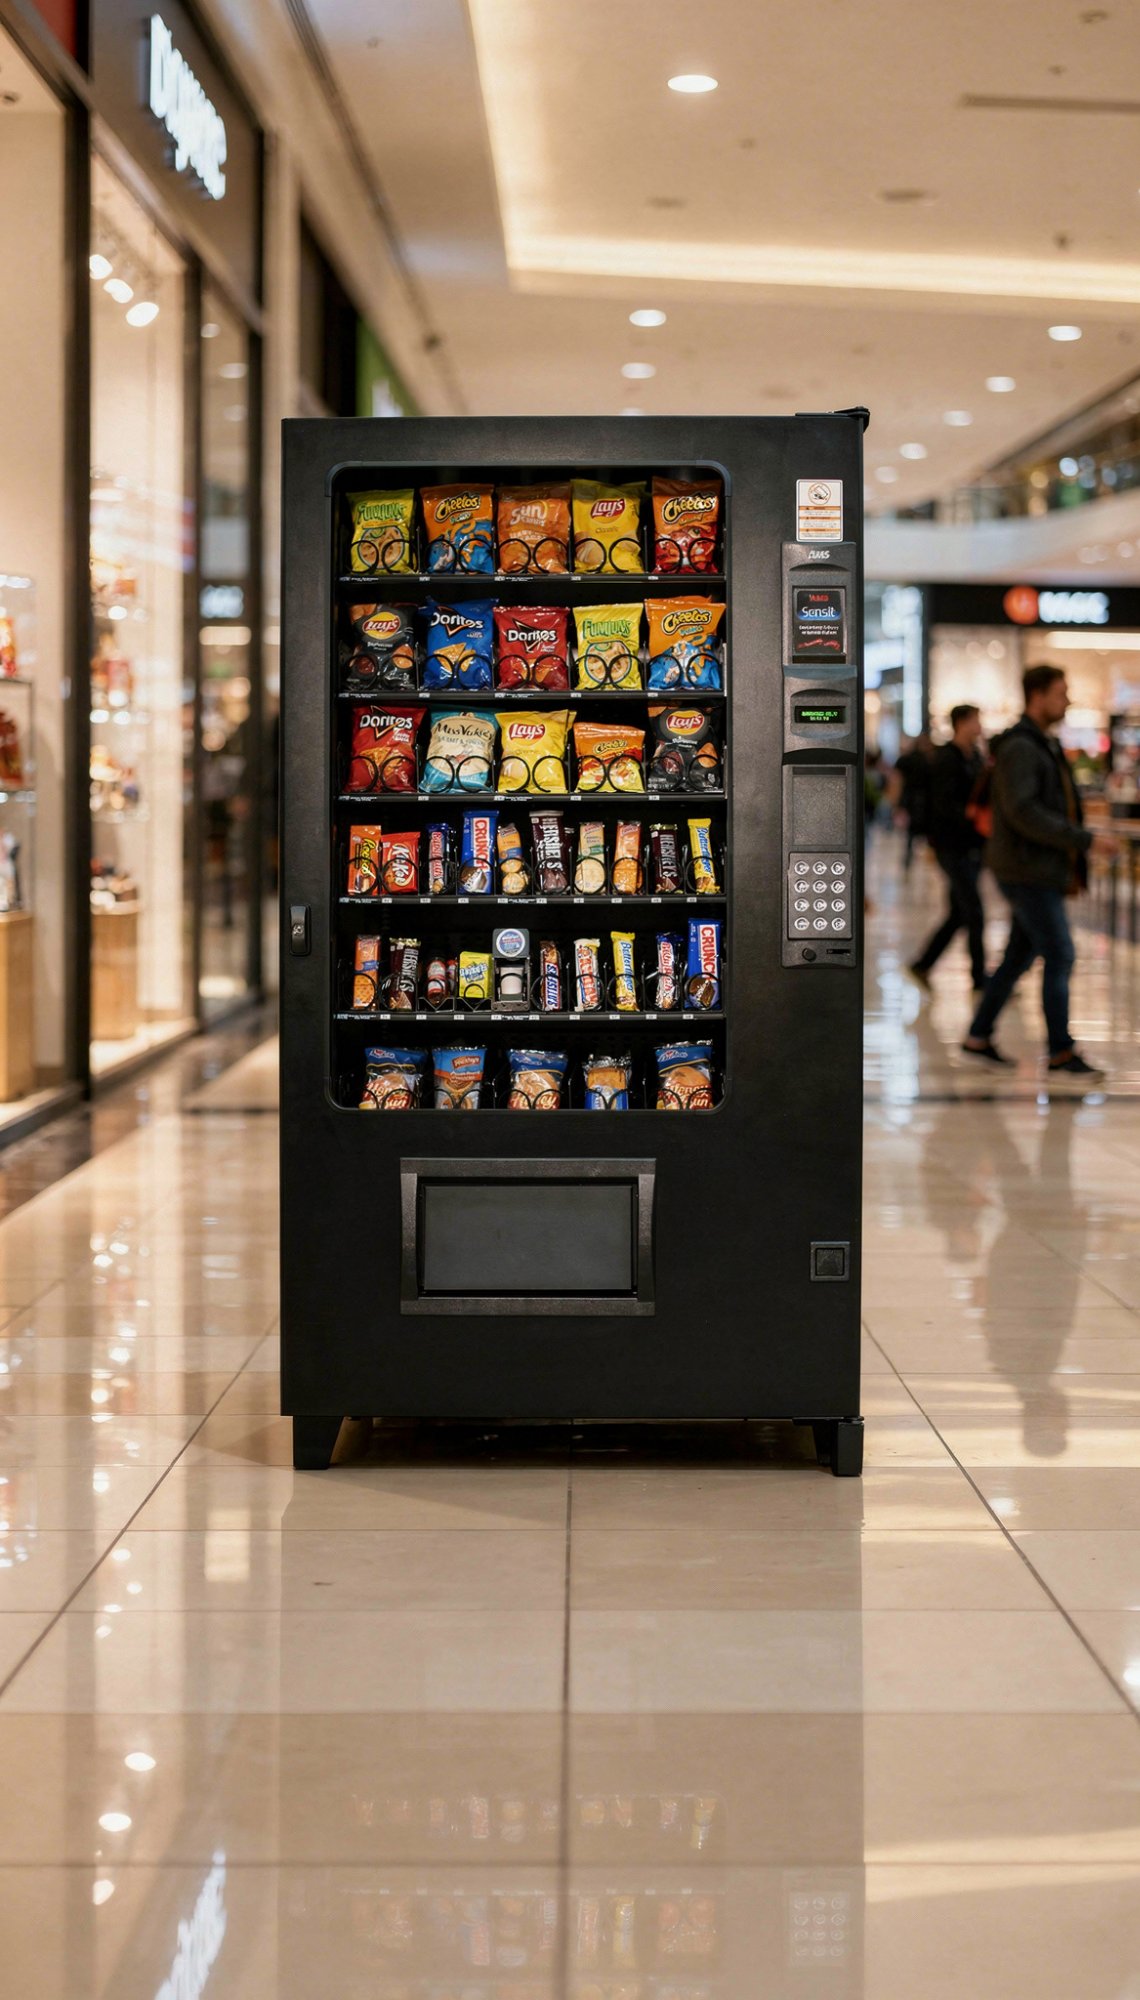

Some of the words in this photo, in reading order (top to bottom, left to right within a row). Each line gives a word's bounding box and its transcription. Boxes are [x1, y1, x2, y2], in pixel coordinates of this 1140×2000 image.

[435, 495, 481, 521] Cheetos
[662, 495, 717, 522] Cheetos
[430, 612, 484, 629] Doritos
[663, 609, 711, 634] Cheetos
[507, 629, 557, 642] Doritos
[360, 714, 413, 728] Doritos
